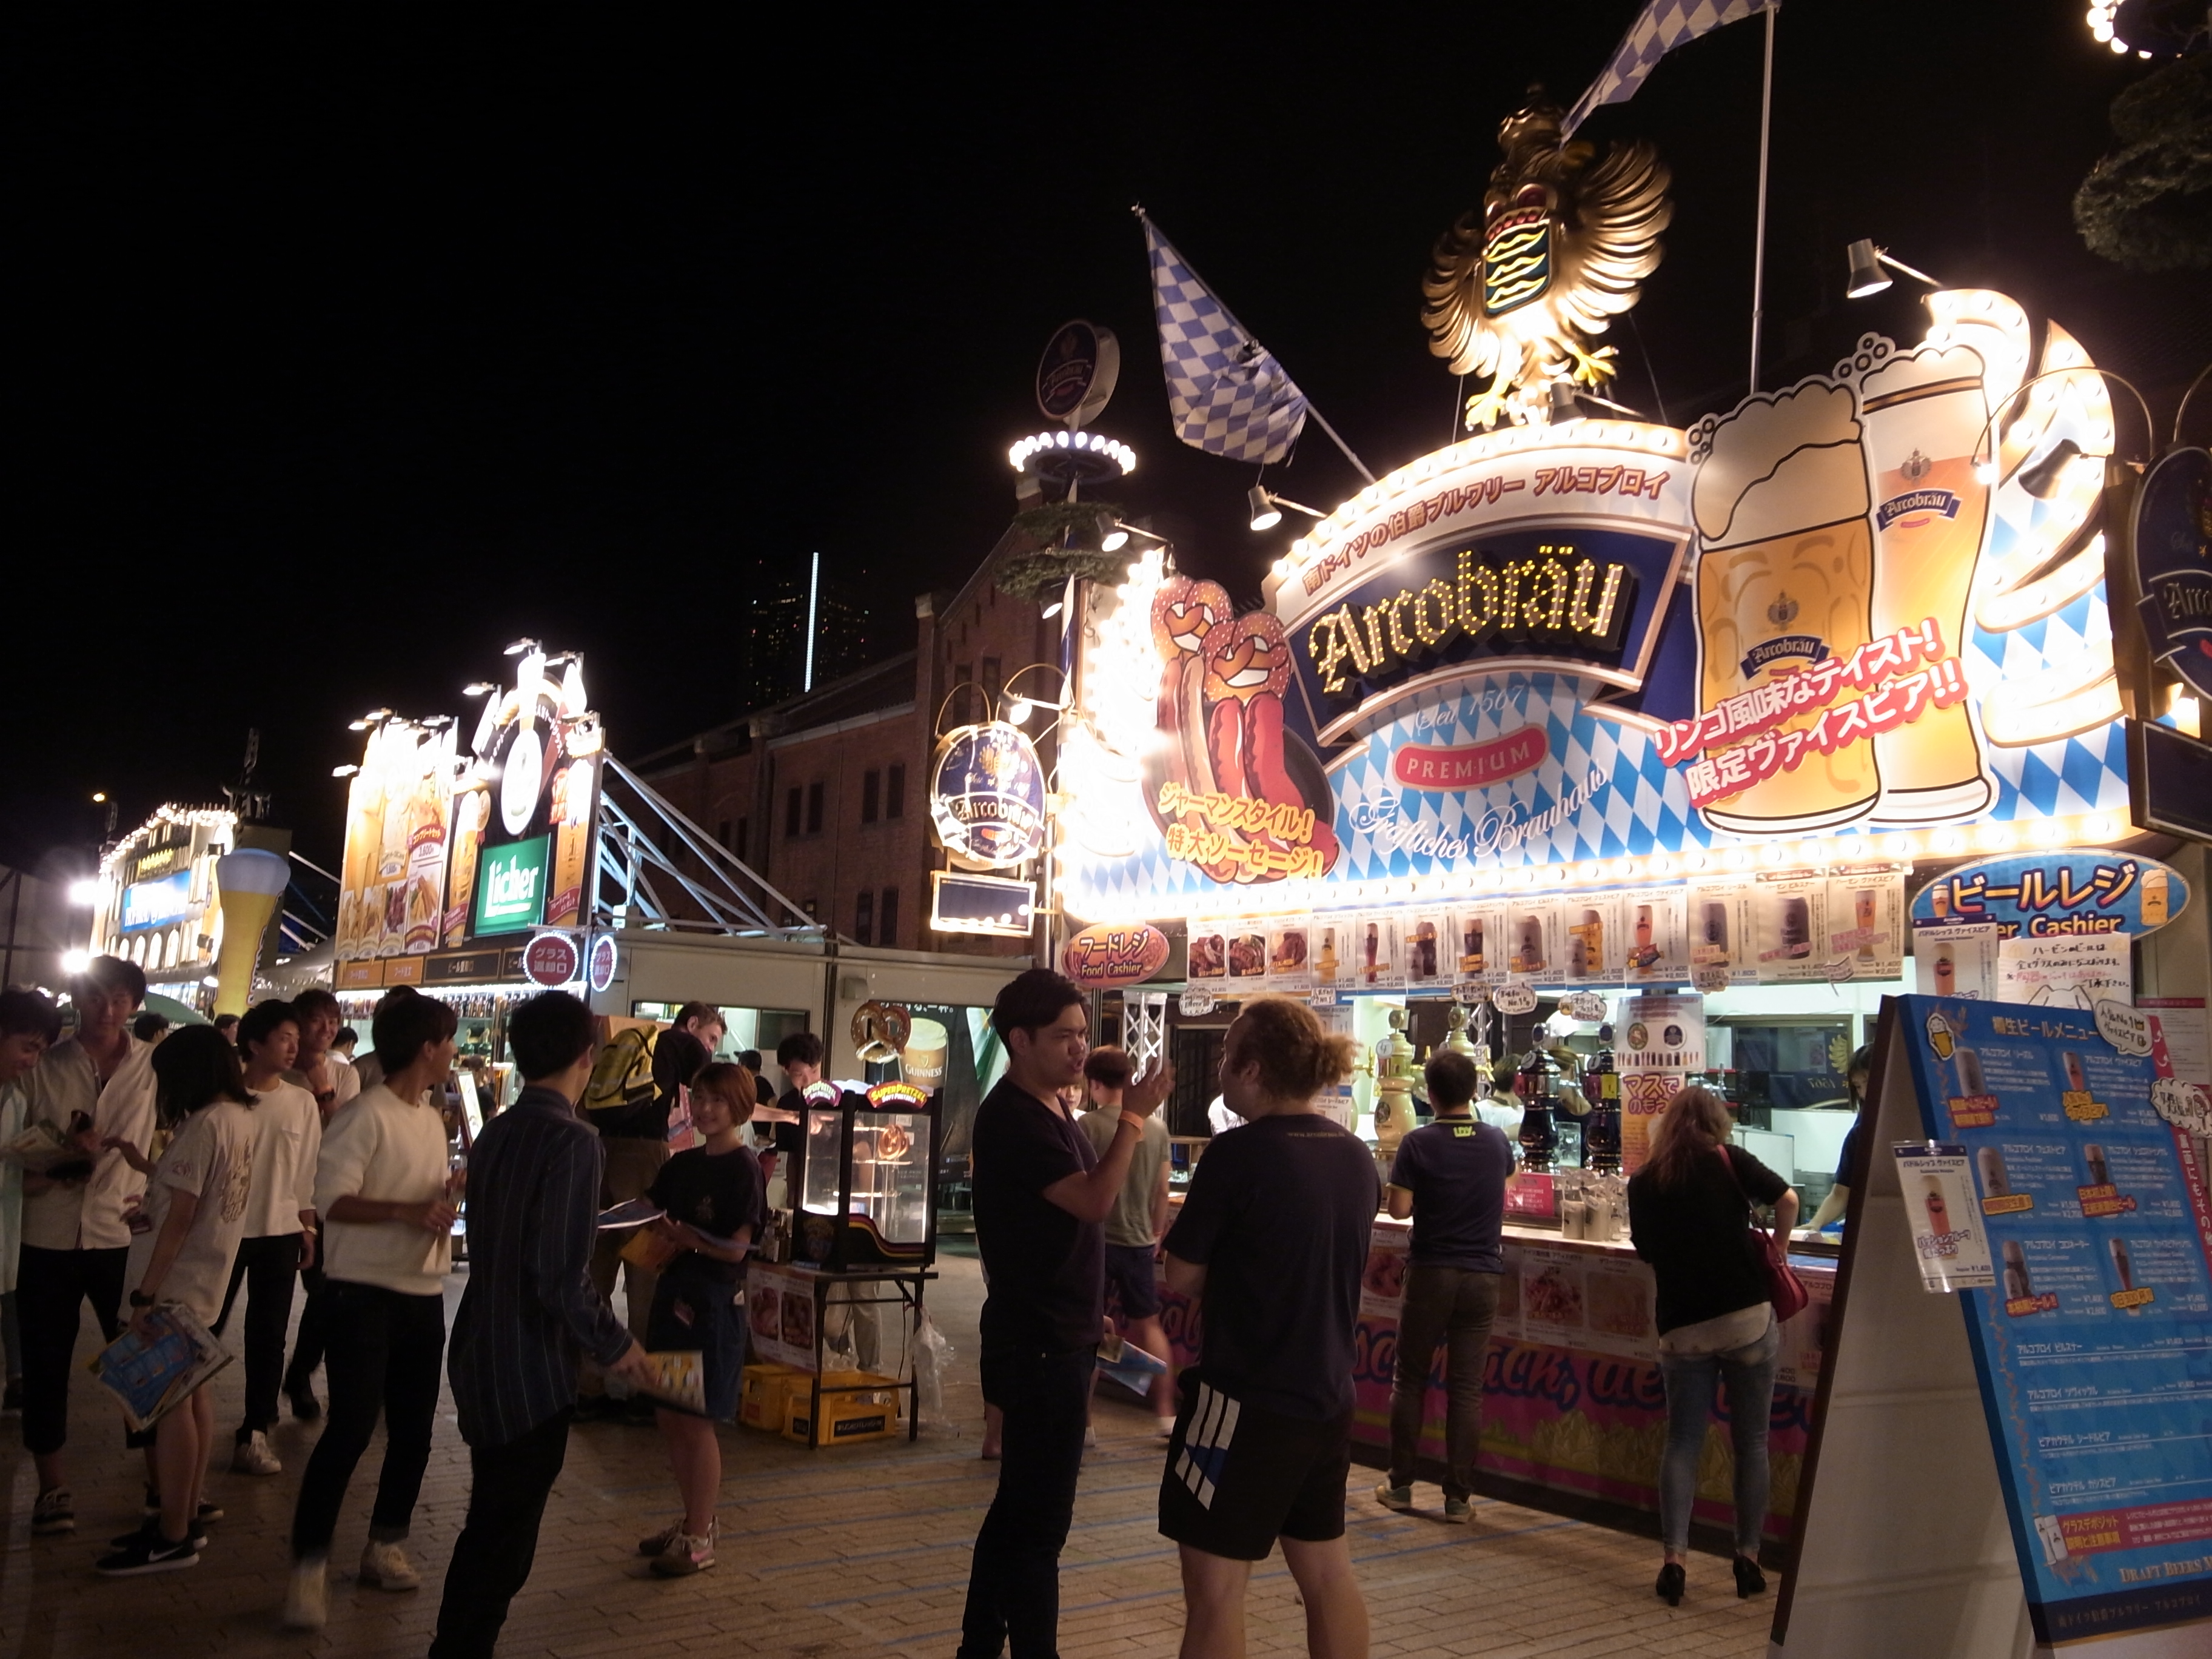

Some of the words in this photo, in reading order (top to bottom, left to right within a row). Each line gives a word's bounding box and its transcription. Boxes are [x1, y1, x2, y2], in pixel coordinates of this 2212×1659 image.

[1884, 492, 1947, 517] Arcobräu
[1302, 477, 1525, 596] 南ドイツの伯爵ブルワリー
[1534, 466, 1671, 500] アルコブロイ
[1309, 546, 1624, 694] Arcobräu
[1754, 638, 1815, 663] Arcobräu
[1468, 684, 1524, 716] 1567
[1407, 741, 1530, 779] PREMIUM
[1159, 782, 1313, 841] ジャーマンスタイル!
[1474, 758, 1609, 857] Brauhaus
[1167, 826, 1322, 879] 特大ソーセージ!
[484, 854, 539, 918] Licher
[1952, 860, 2139, 913] ビールレジ
[2031, 914, 2122, 937] Cashier
[535, 947, 567, 958] グラス
[1079, 931, 1150, 956] フードレジ
[1081, 964, 1104, 979] Food
[1107, 962, 1142, 977] Cashier
[905, 1064, 943, 1078] GUINNESS
[871, 1083, 927, 1102] SUPERPRETZEL
[2063, 1515, 2120, 1533] グラスデポジット
